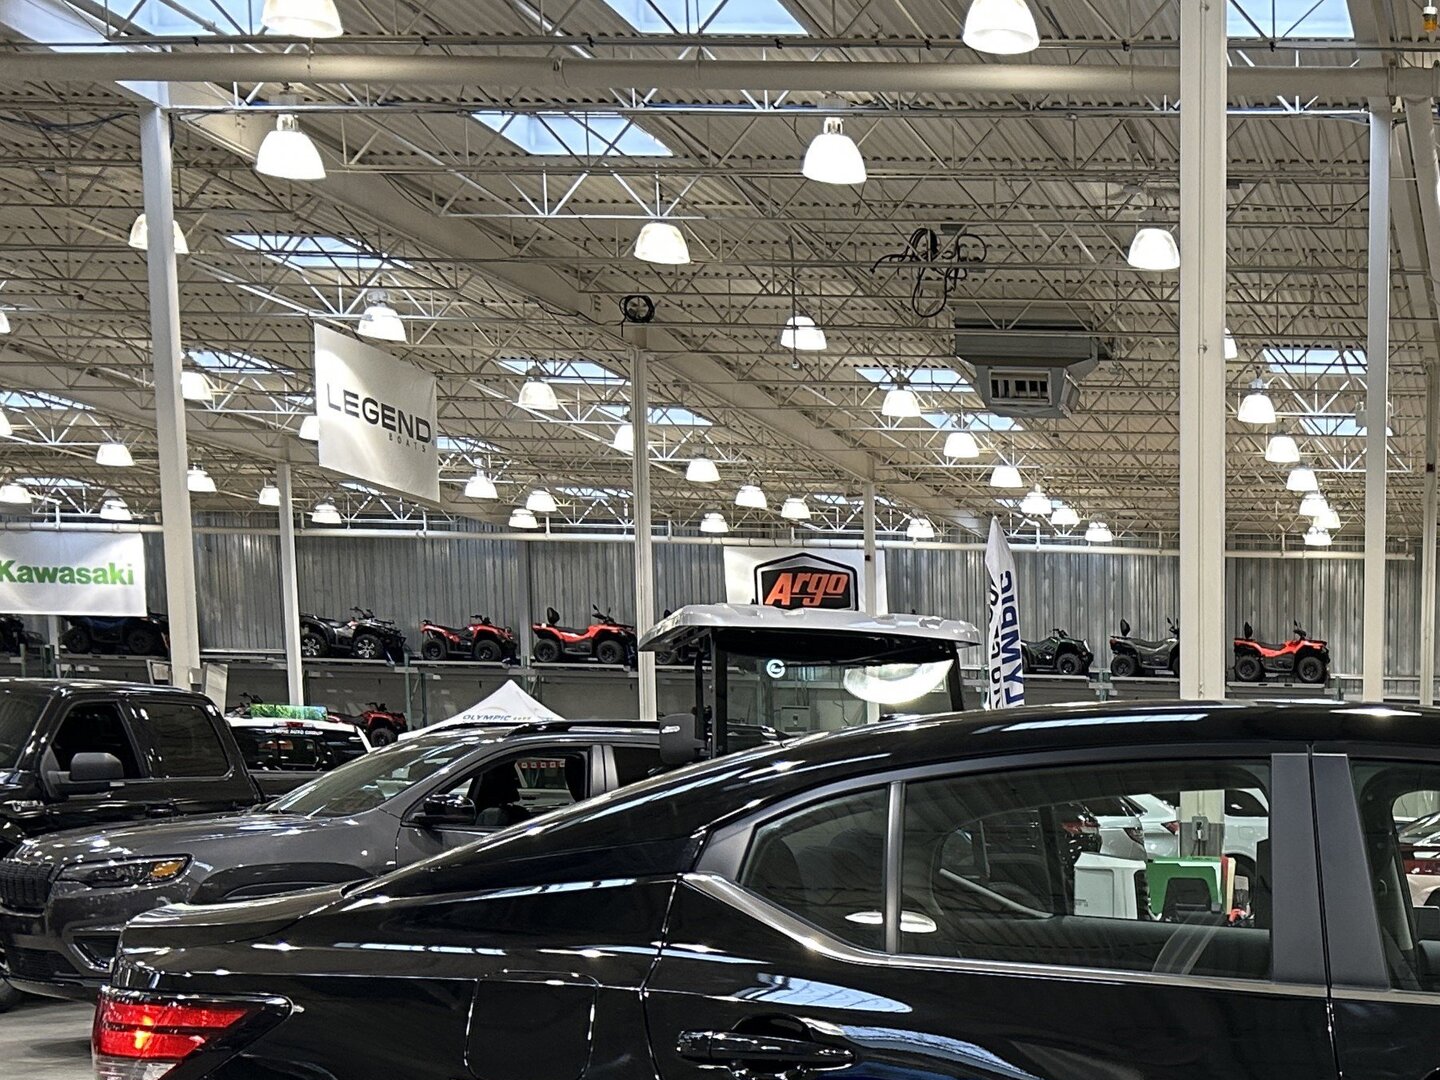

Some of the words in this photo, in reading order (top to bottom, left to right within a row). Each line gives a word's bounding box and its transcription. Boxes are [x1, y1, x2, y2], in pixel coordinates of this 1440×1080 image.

[326, 382, 432, 444] LEGEND
[388, 432, 426, 453] BOATS
[0, 559, 135, 585] Kawasaki
[764, 572, 849, 606] Argo
